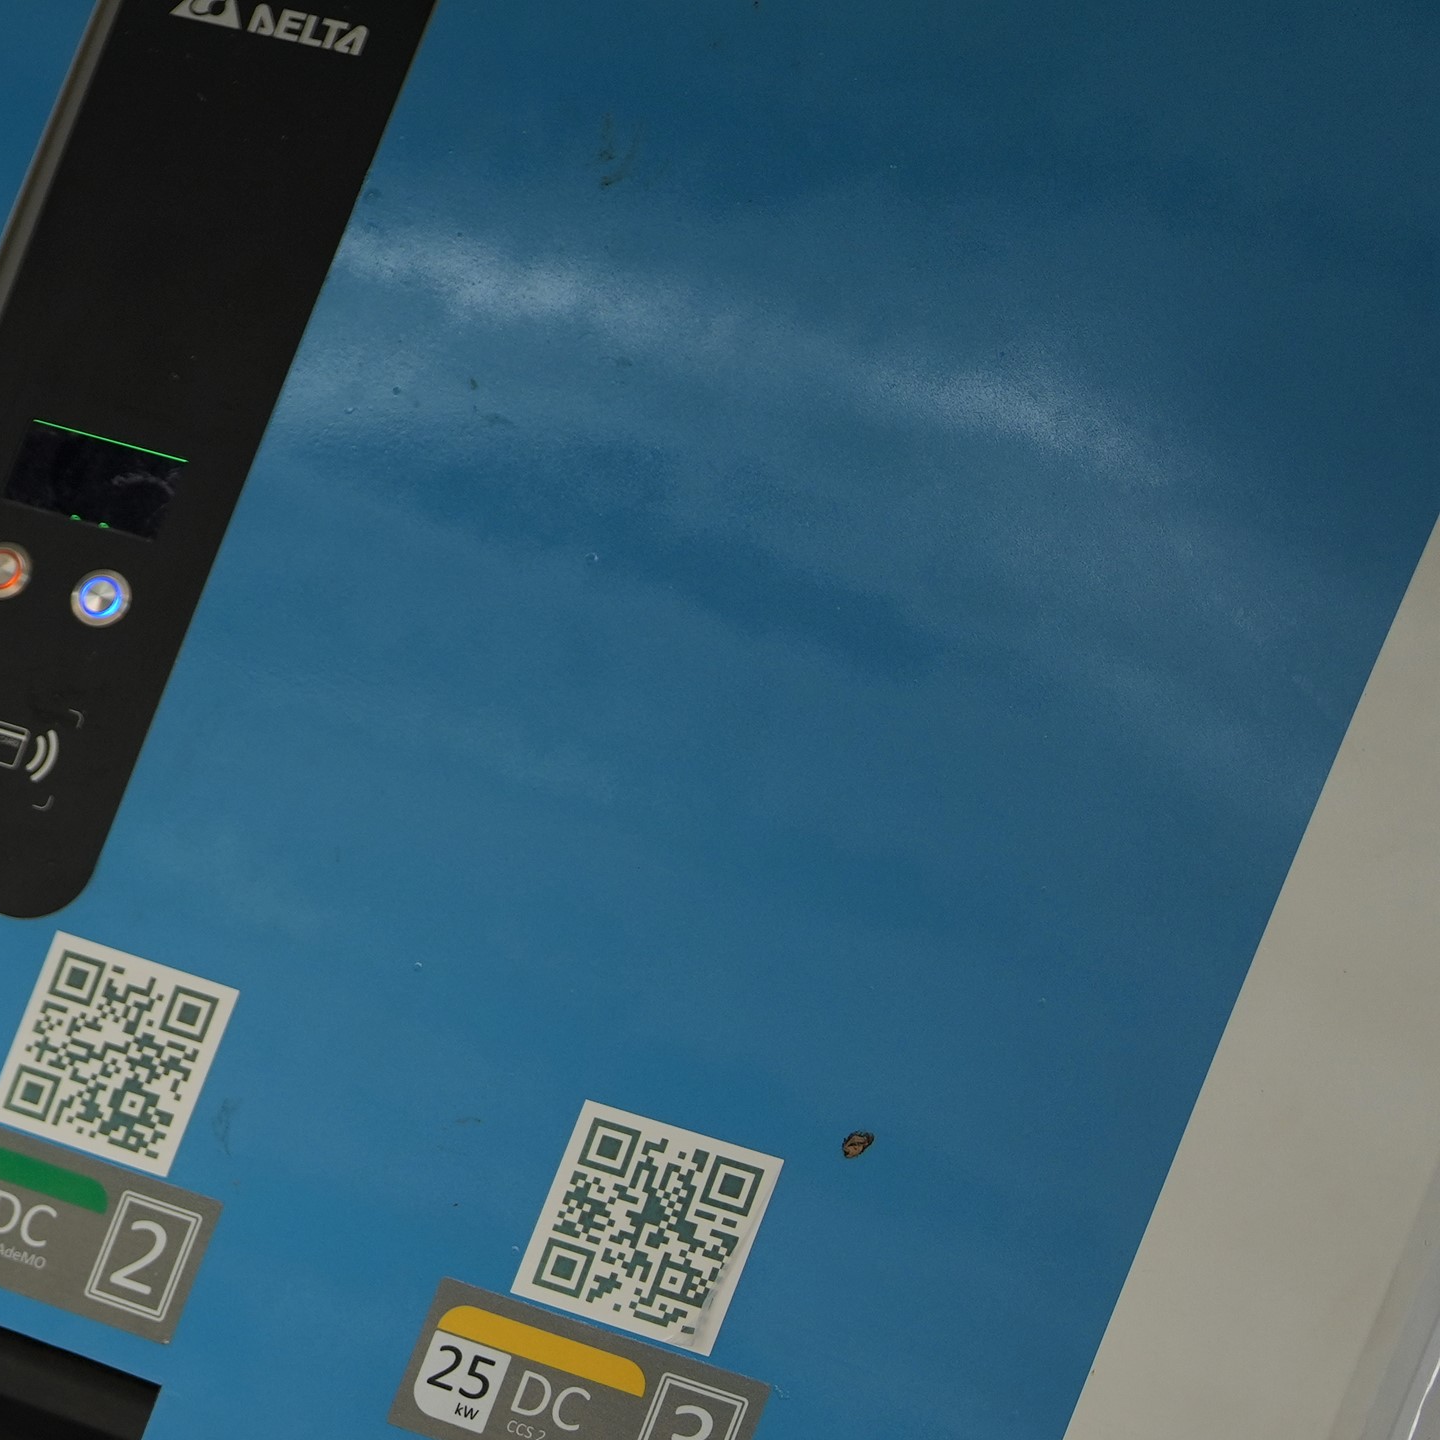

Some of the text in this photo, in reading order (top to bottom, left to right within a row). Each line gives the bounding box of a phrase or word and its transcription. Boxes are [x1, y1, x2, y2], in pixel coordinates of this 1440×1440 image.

[248, 3, 370, 56] DELTA
[108, 1218, 169, 1297] 2
[426, 1343, 497, 1401] 25
[509, 1368, 593, 1432] DC
[453, 1401, 480, 1422] kW
[506, 1419, 535, 1440] CCS
